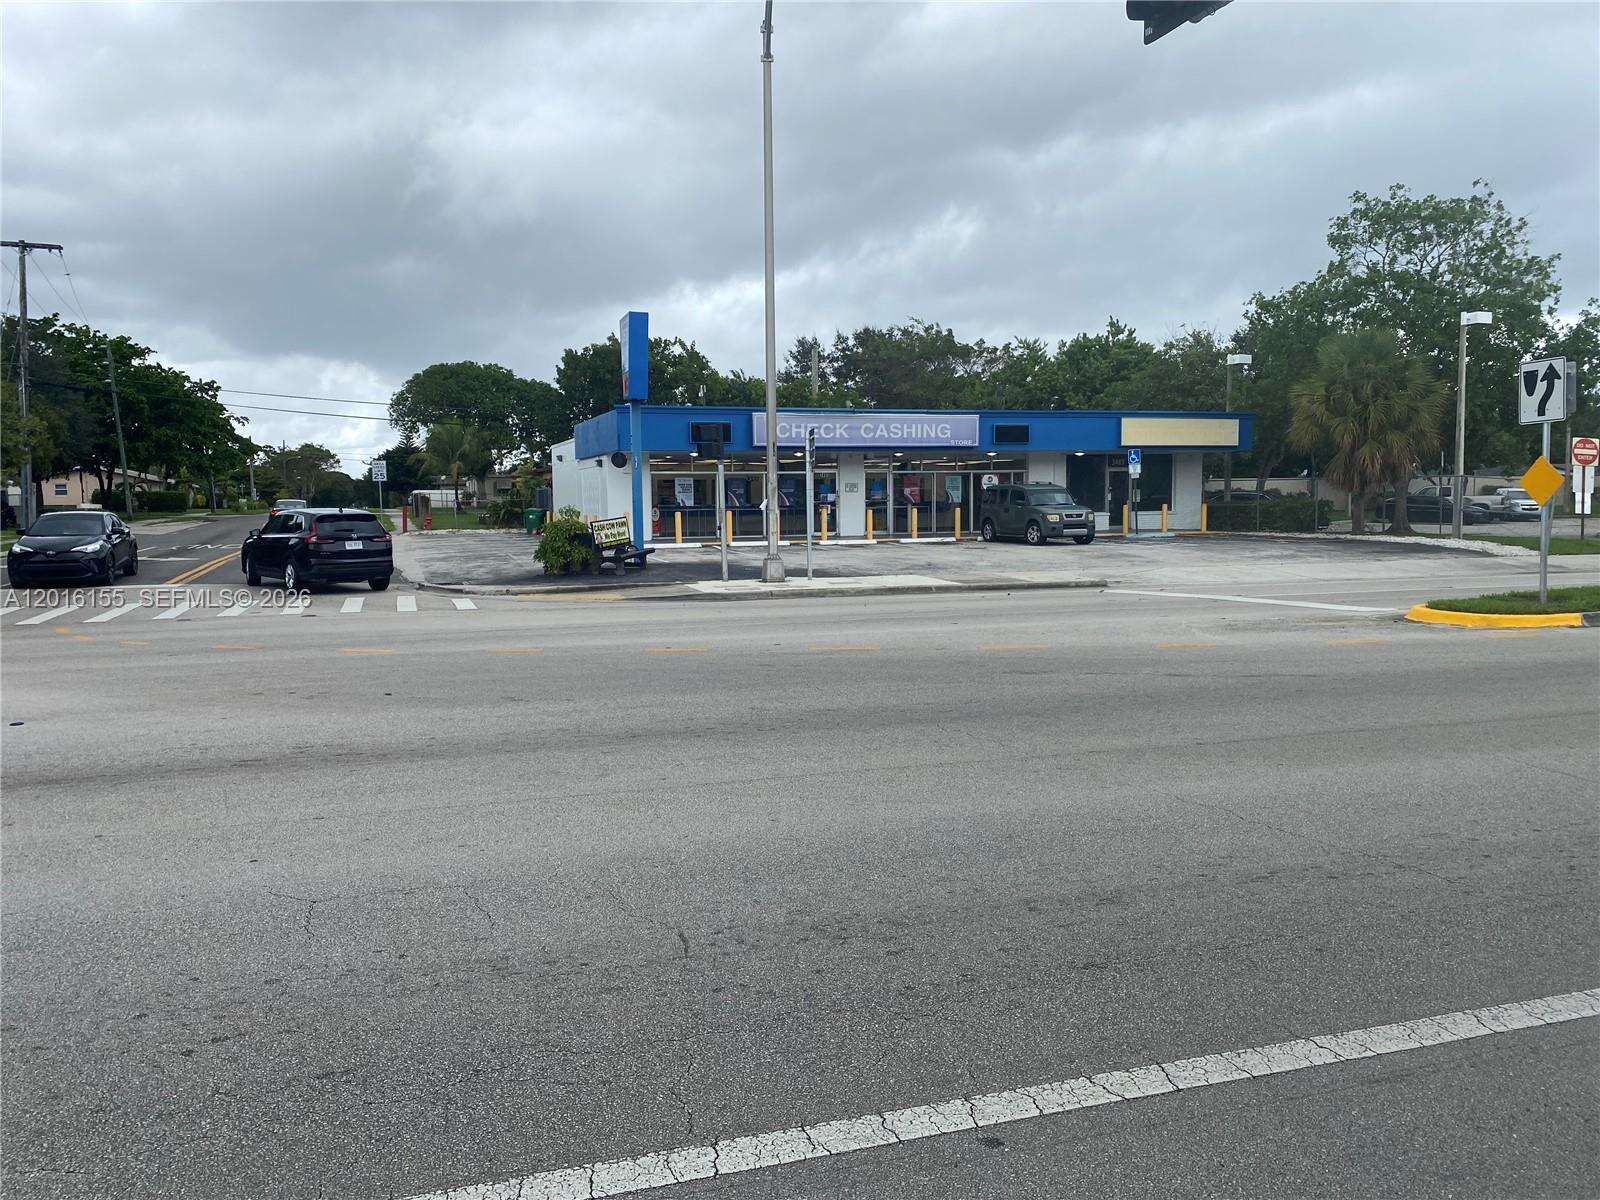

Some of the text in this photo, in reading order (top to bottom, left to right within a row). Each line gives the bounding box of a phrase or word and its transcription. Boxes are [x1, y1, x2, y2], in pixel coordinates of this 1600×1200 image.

[776, 422, 952, 438] CHECK CASHING
[373, 472, 386, 480] 25
[594, 522, 606, 532] CASH
